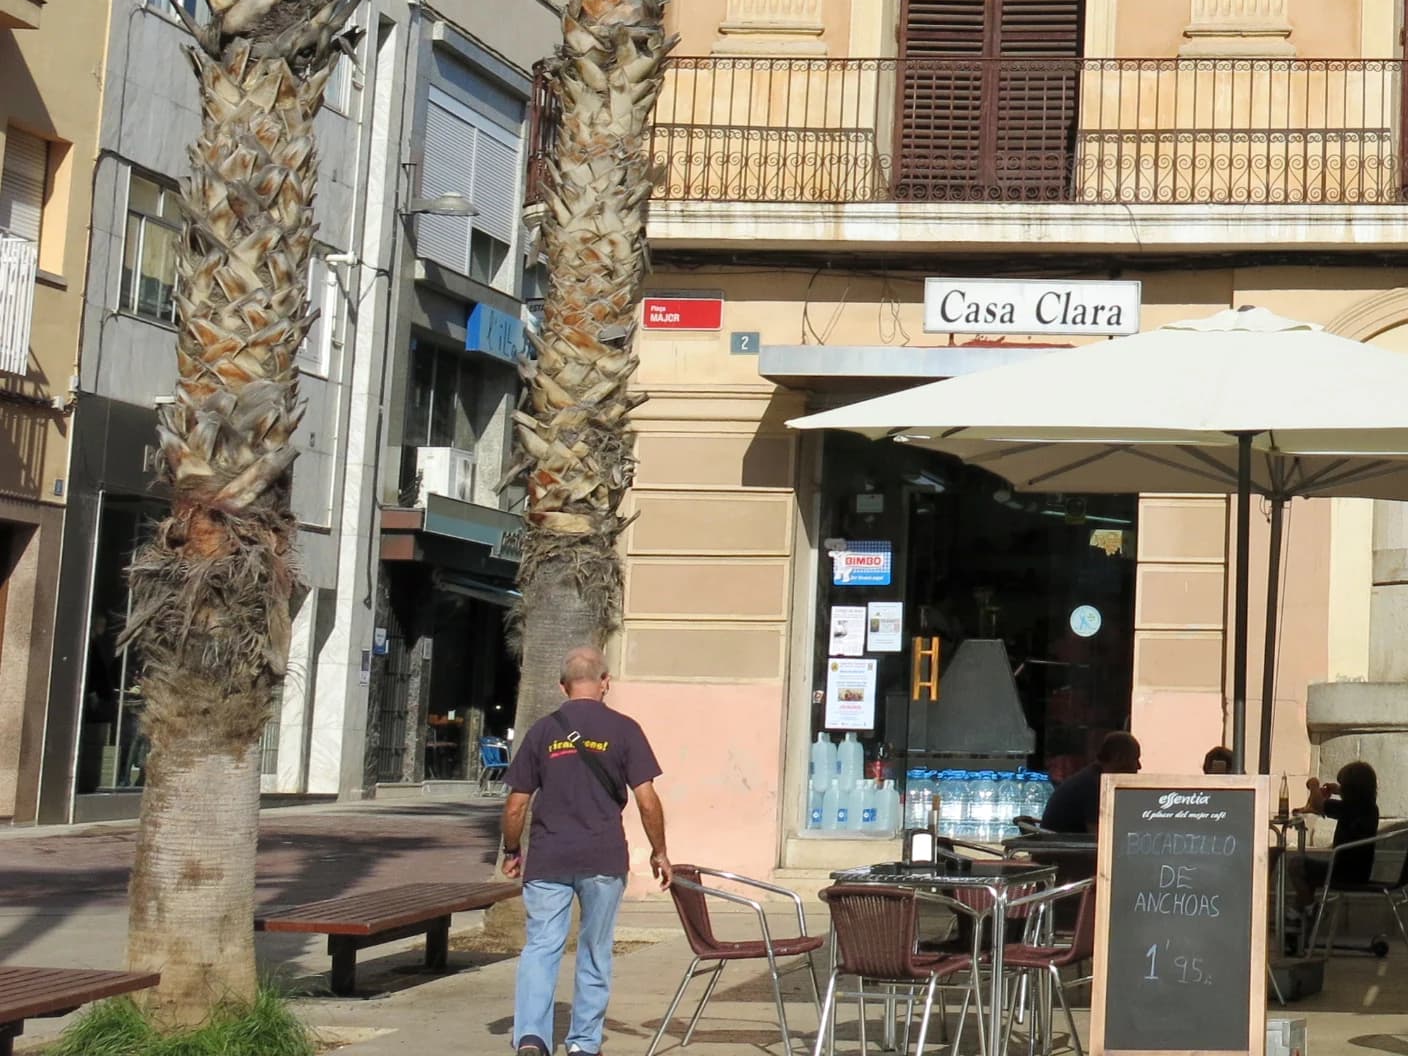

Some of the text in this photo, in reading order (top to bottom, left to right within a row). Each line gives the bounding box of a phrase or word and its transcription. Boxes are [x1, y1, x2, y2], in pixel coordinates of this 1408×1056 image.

[940, 289, 1122, 326] Casa Clara
[650, 313, 680, 323] MAJOR
[741, 335, 750, 350] 2
[845, 556, 882, 566] BIMBO
[1158, 791, 1211, 809] essentia
[1174, 810, 1189, 818] del
[1187, 811, 1209, 820] mejor
[1127, 832, 1236, 856] BOCADILLO
[1160, 864, 1196, 889] DE
[1134, 892, 1220, 917] ANCHOAS
